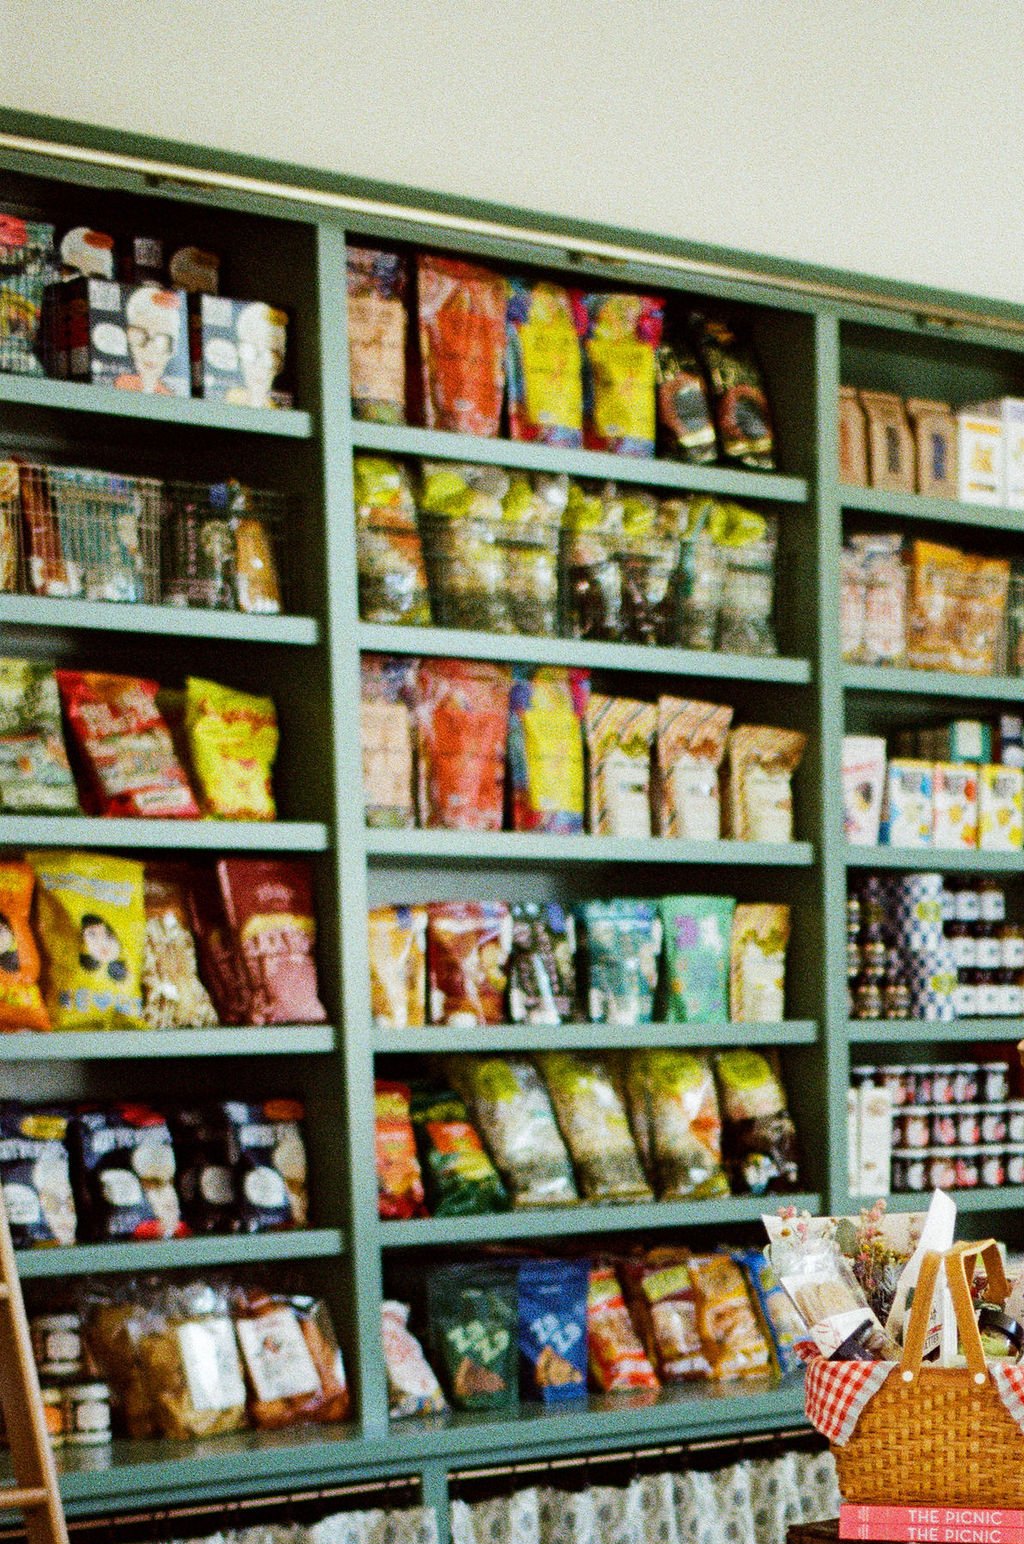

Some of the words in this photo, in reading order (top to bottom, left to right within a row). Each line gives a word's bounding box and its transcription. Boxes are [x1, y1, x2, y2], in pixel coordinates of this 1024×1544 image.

[908, 1509, 939, 1523] THE
[945, 1510, 1003, 1525] PICNIC
[907, 1527, 938, 1541] THE
[945, 1529, 1002, 1543] PICNIC
